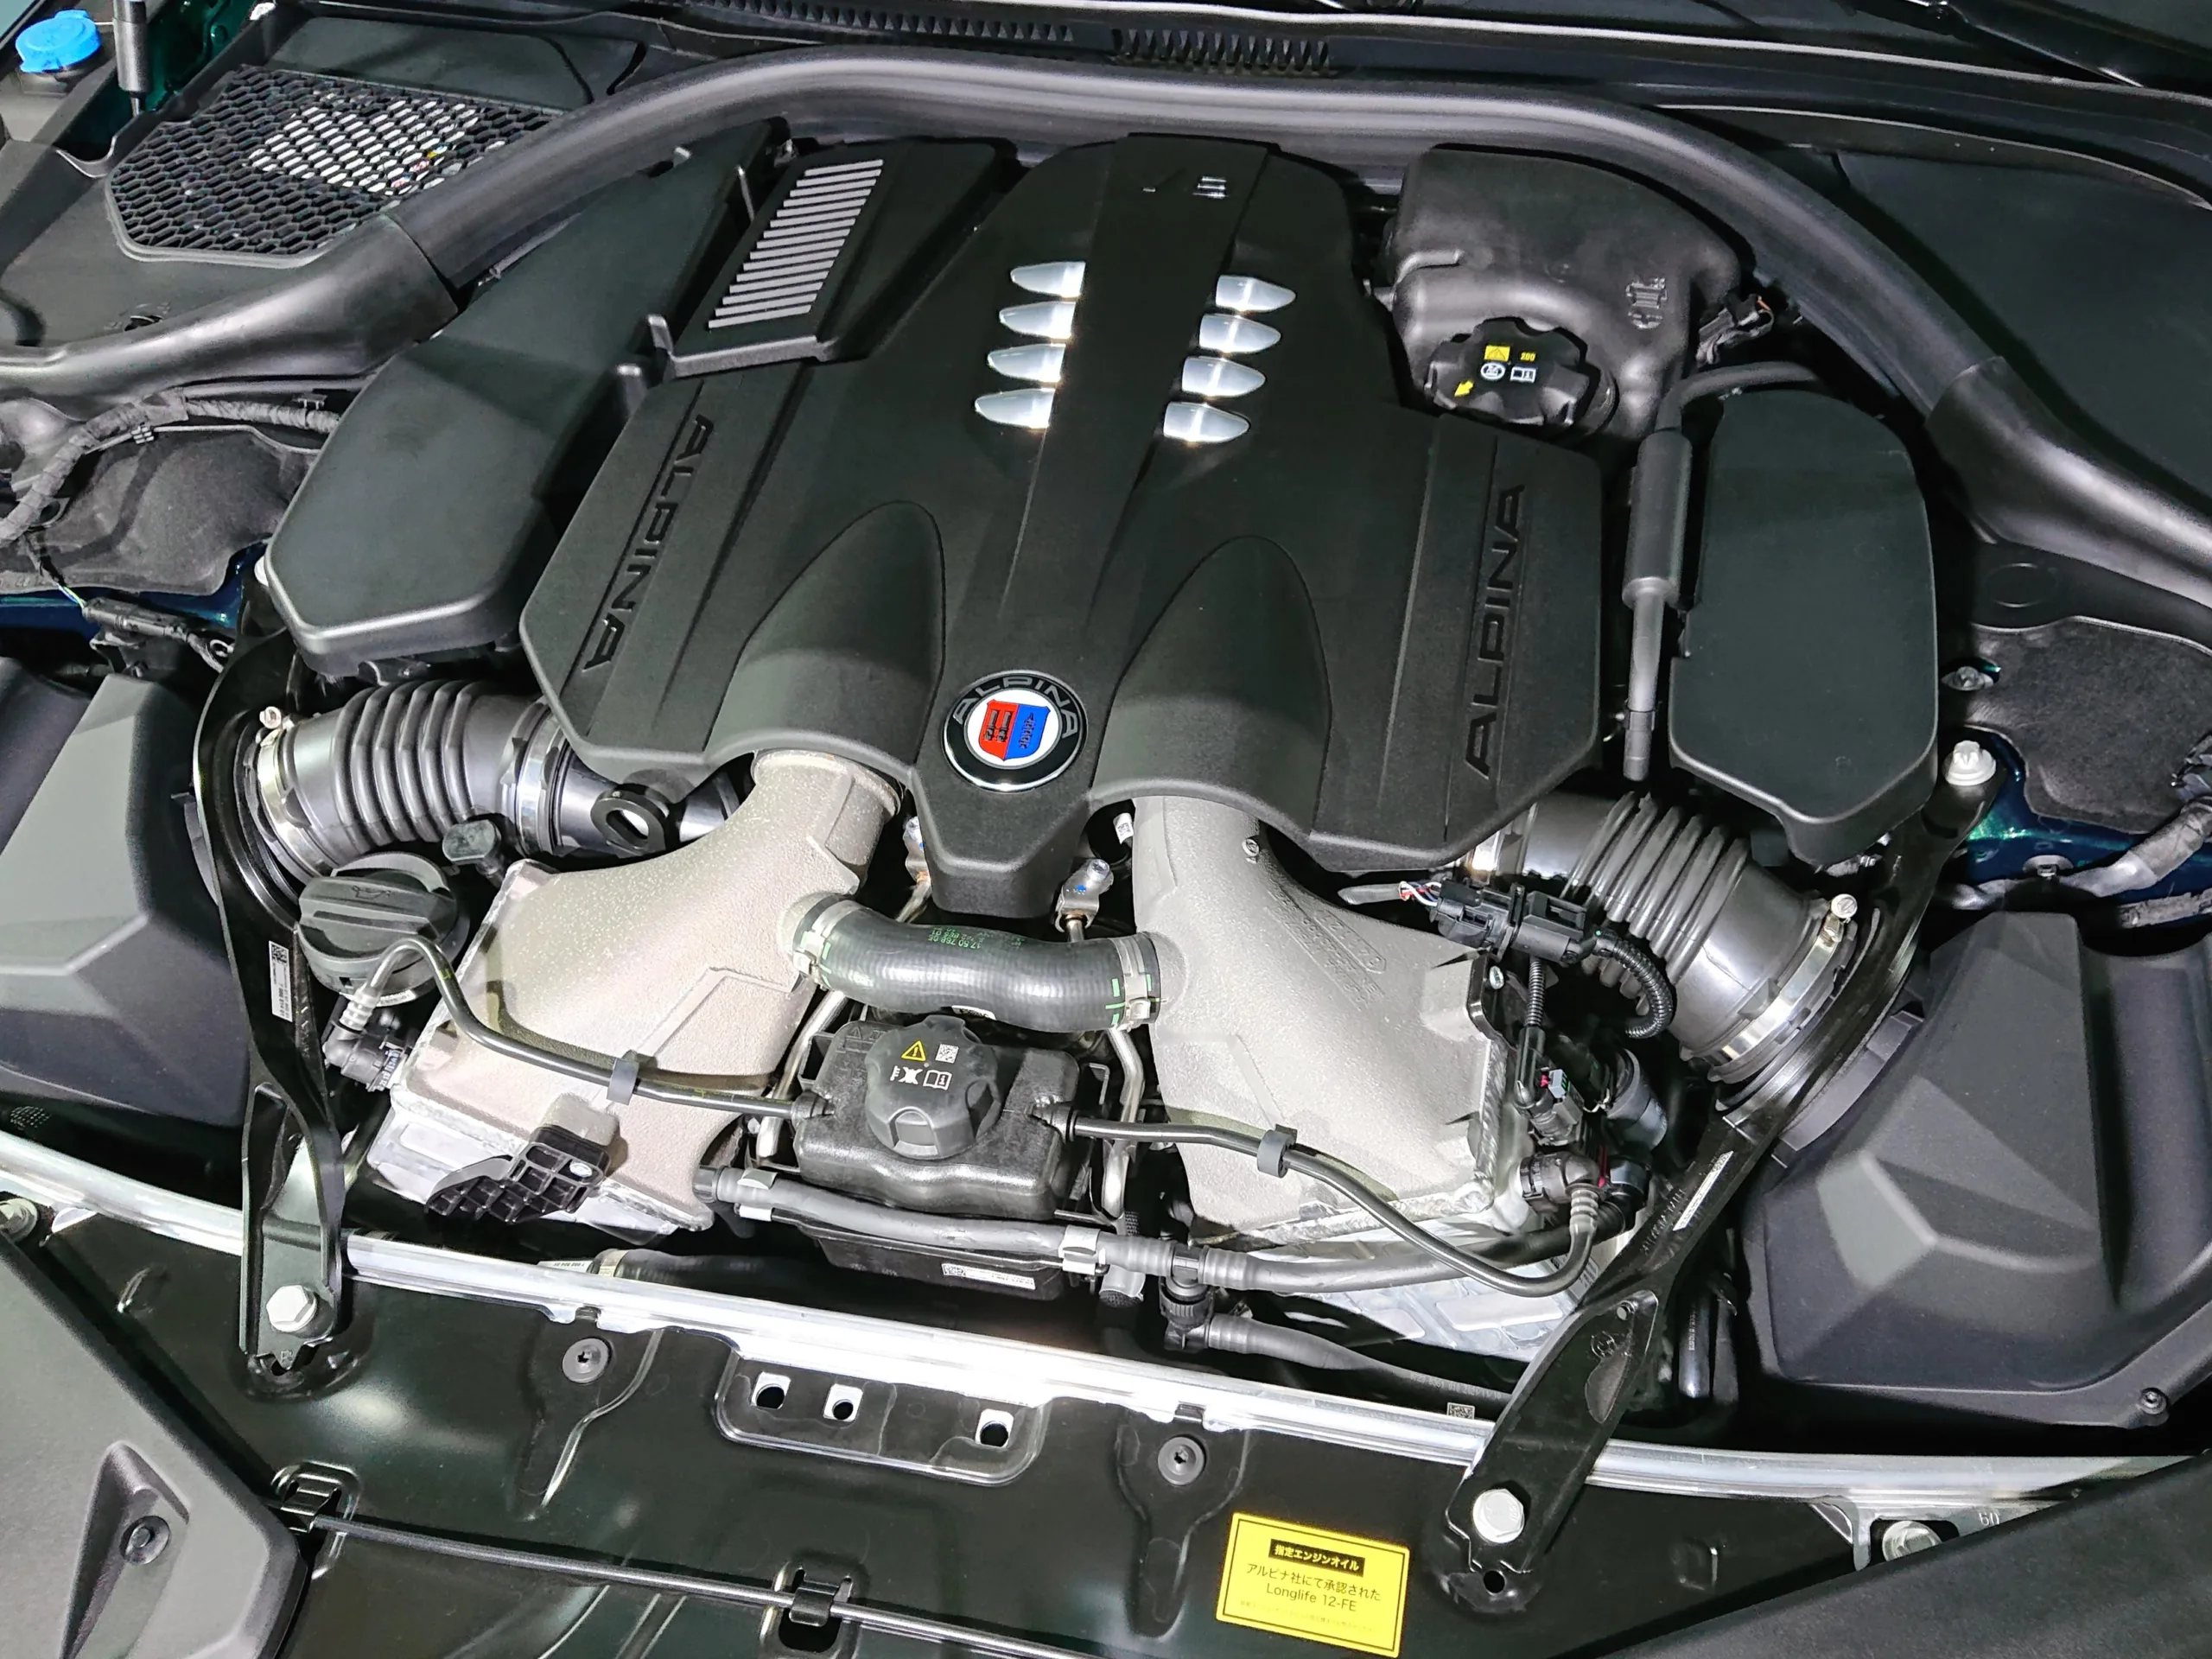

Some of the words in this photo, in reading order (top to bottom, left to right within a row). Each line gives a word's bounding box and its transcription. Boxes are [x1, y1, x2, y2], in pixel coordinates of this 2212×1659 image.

[582, 414, 715, 673] ALPINA
[1465, 484, 1525, 779] ALPINA
[952, 676, 1079, 739] ALPINA
[1274, 1544, 1360, 1572] 指定エンジンオイル
[1266, 1583, 1318, 1605] Longlife
[1322, 1594, 1358, 1612] 12-FE
